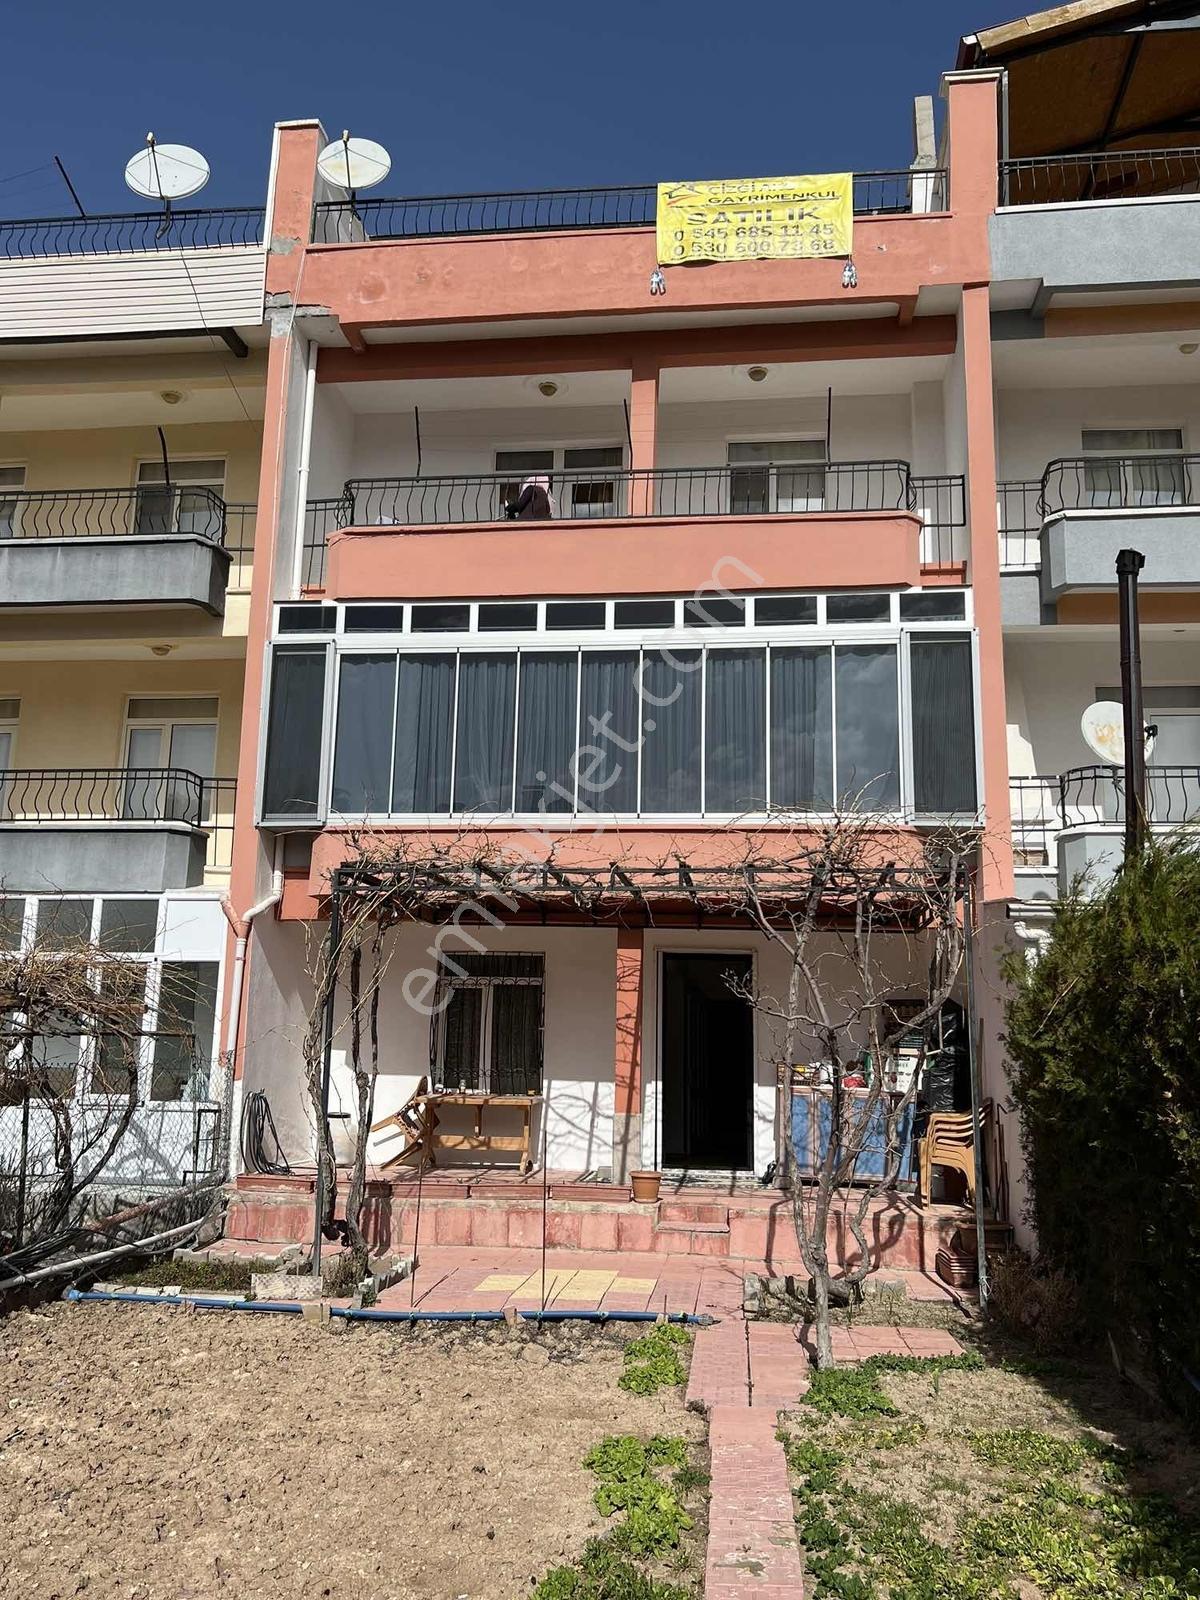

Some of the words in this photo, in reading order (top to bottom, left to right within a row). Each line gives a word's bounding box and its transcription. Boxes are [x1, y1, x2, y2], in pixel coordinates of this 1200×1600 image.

[708, 190, 841, 204] GAYRİMENKUL
[687, 206, 821, 226] SATILIK
[674, 229, 685, 242] 0
[692, 227, 728, 240] 545
[735, 225, 773, 238] 685
[780, 224, 803, 237] 11
[810, 223, 834, 236] 45
[674, 244, 685, 256] 0
[691, 241, 728, 255] 530
